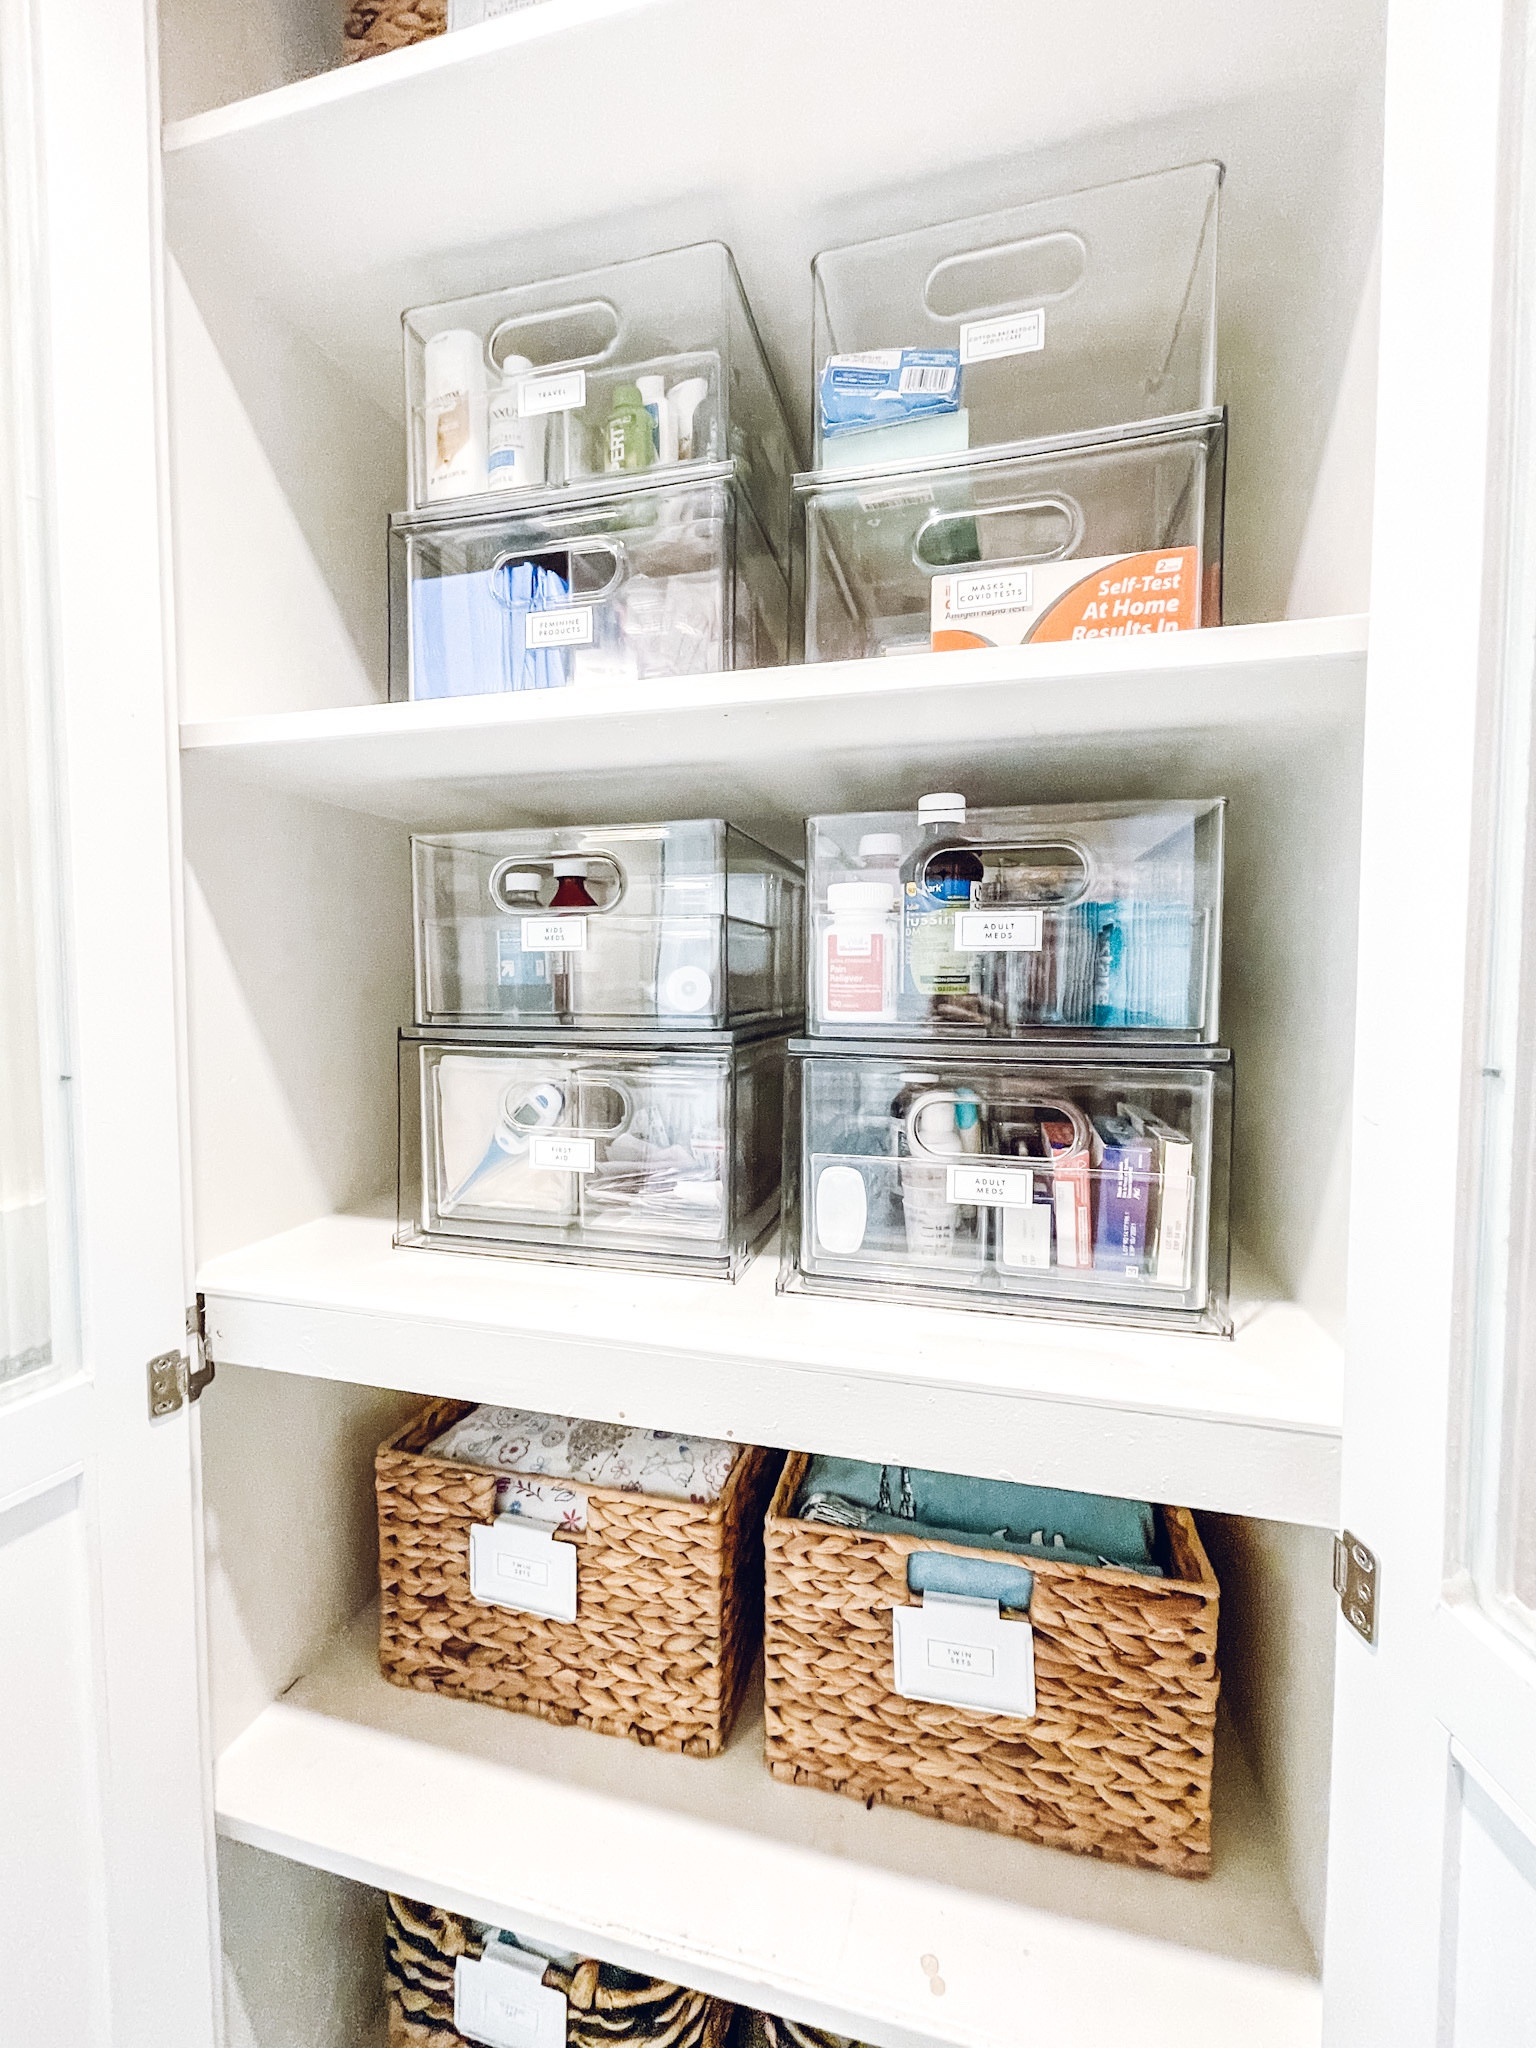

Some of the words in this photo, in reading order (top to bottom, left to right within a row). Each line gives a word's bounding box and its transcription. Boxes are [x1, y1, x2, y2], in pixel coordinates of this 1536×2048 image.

[538, 390, 566, 398] TRAVEL
[972, 582, 1004, 591] MASKS
[1098, 574, 1181, 596] Self-Test
[960, 592, 990, 602] COVID
[994, 589, 1022, 598] TESTS
[1082, 601, 1109, 620] At
[1112, 598, 1179, 617] Home
[540, 618, 579, 628] FEMININE
[539, 626, 581, 637] PRODUCTS
[1072, 620, 1151, 640] Results
[830, 964, 847, 974] Pain
[975, 1178, 1005, 1186] ADULT
[948, 1649, 971, 1658] TWIN
[951, 1657, 971, 1666] SETS
